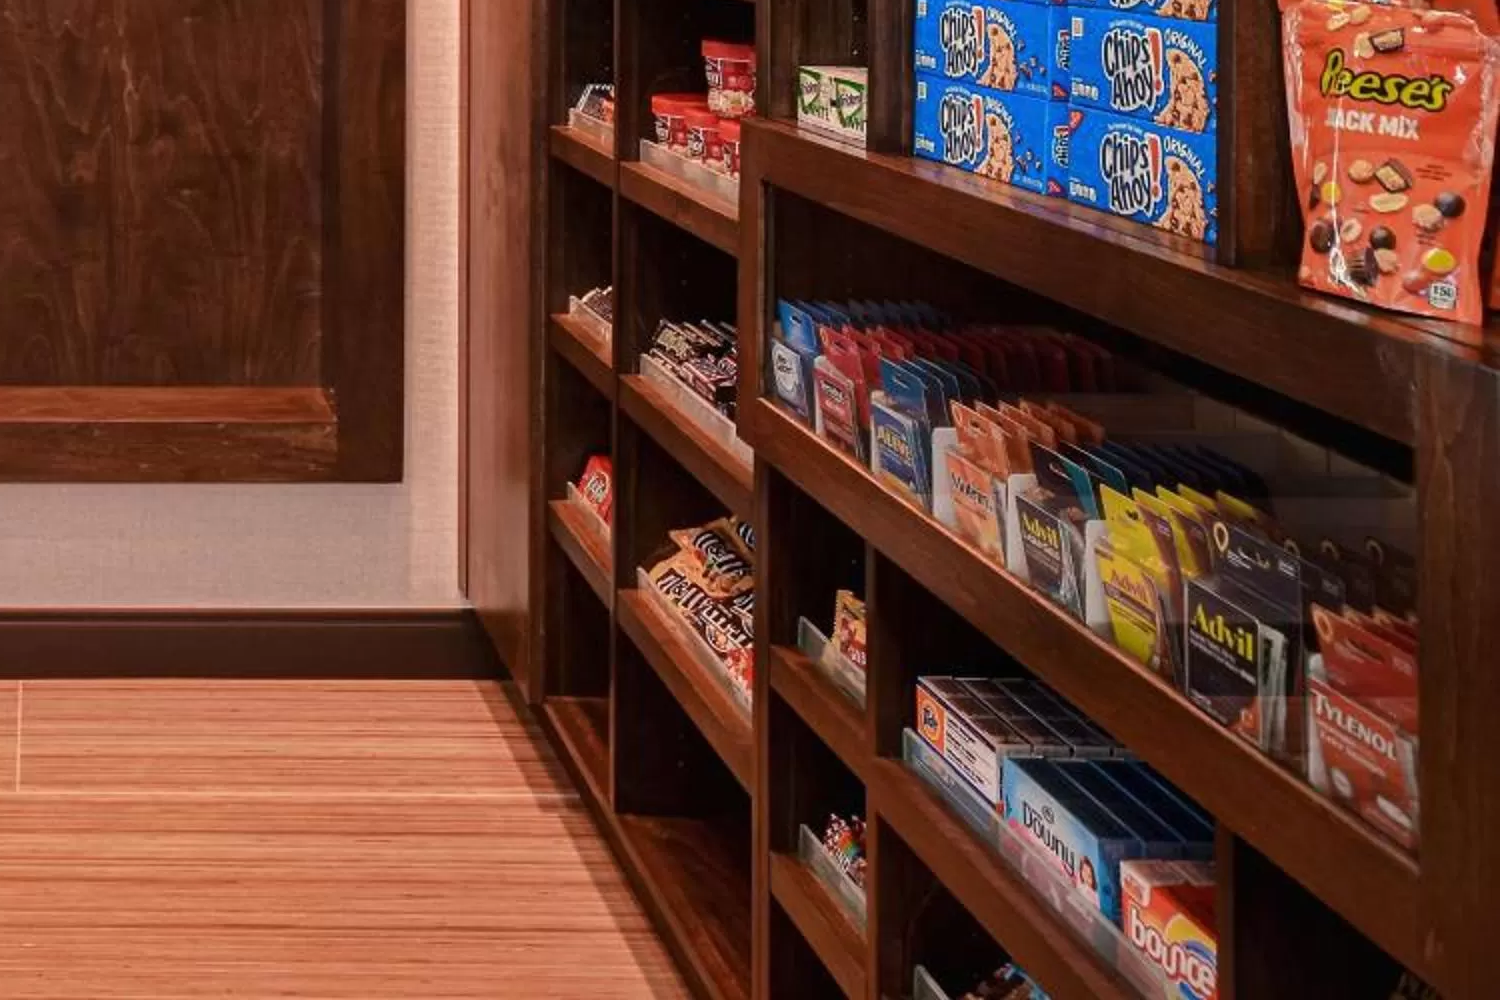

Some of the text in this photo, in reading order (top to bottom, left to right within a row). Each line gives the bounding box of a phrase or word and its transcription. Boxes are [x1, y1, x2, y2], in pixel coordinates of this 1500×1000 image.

[940, 7, 976, 48] Chips
[1103, 29, 1150, 76] Chips
[1320, 47, 1456, 113] Reese's
[1101, 133, 1150, 178] Chips
[1020, 513, 1061, 552] Advil
[1191, 602, 1256, 663] Advil
[1313, 690, 1398, 762] TYLENOL
[1022, 798, 1077, 876] Downy
[1129, 905, 1217, 995] bounce
